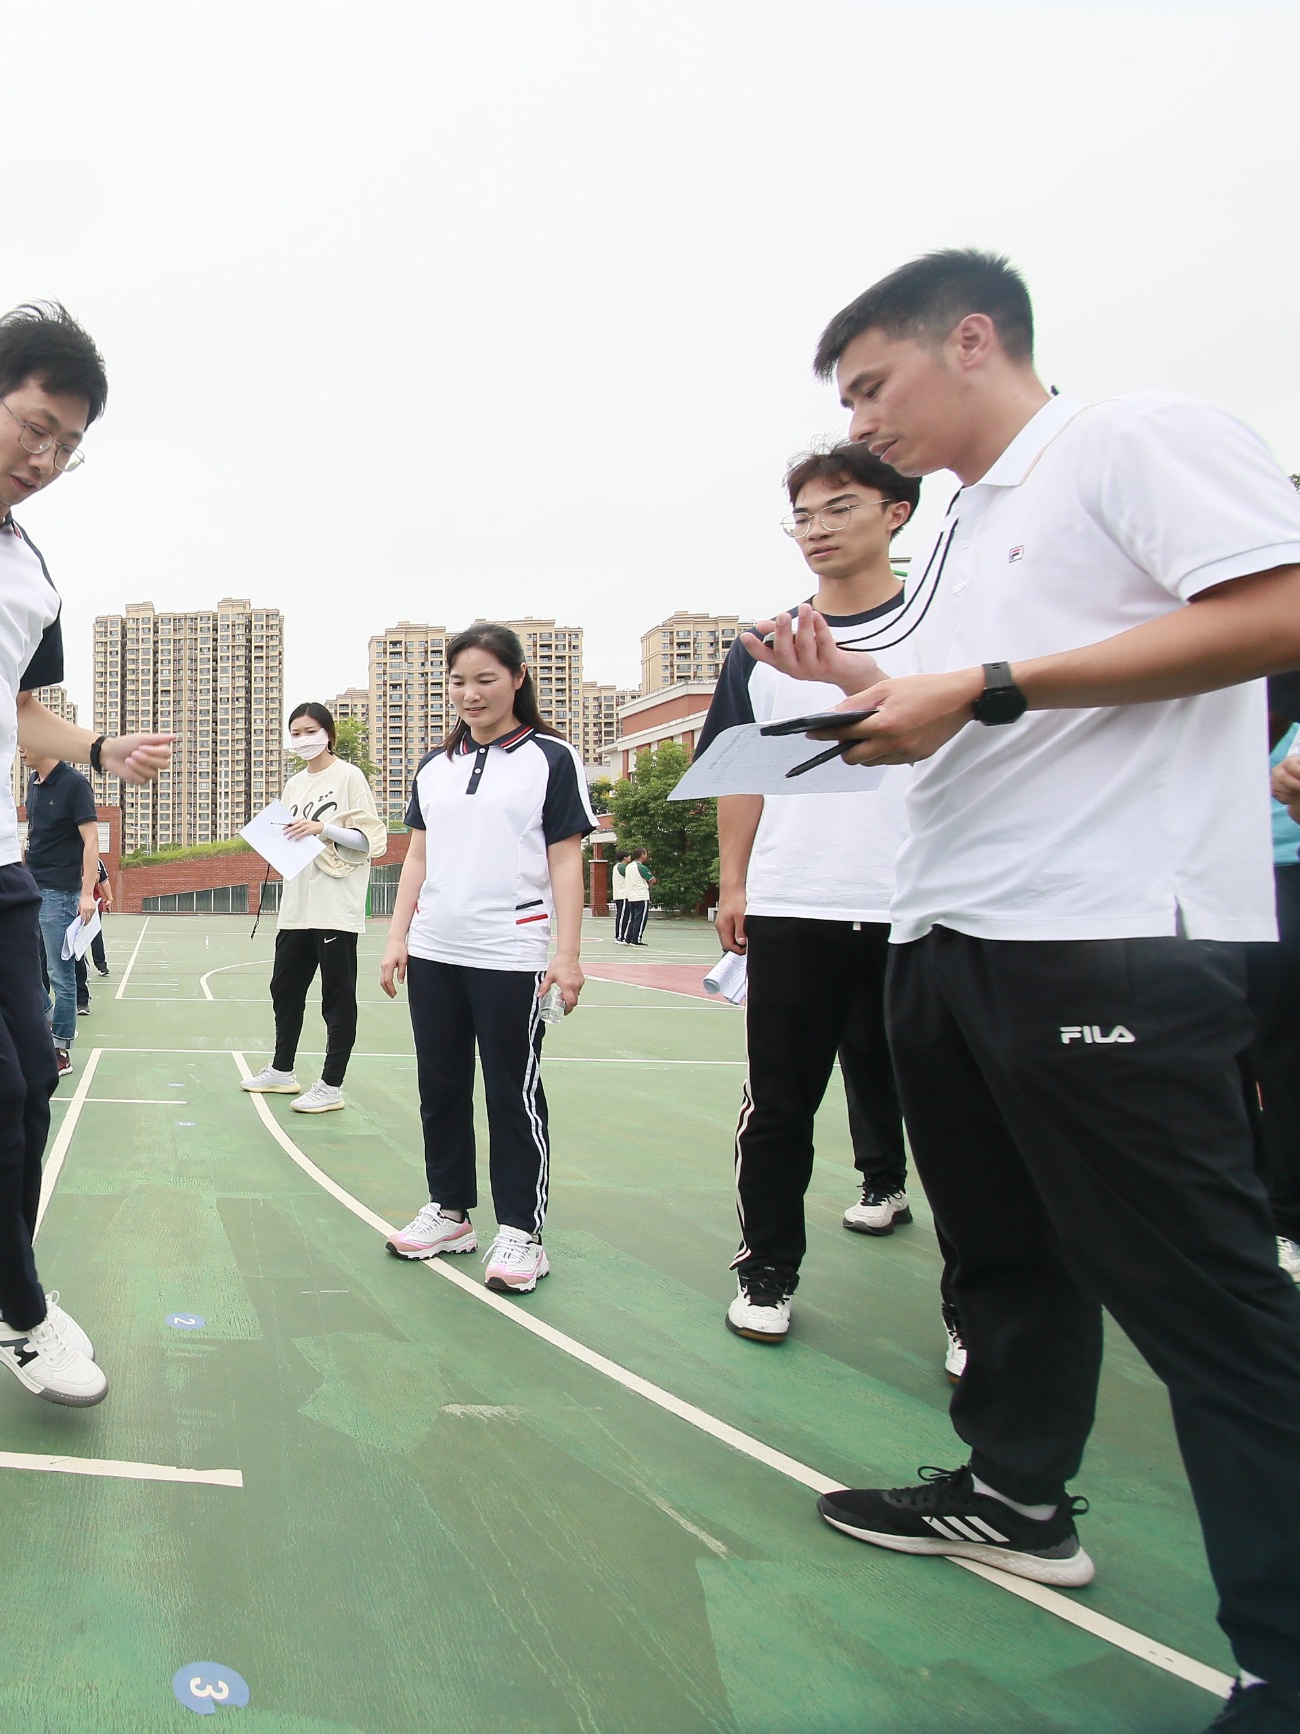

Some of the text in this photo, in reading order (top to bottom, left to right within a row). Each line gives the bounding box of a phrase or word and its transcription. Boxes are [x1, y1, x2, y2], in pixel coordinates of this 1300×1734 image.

[1060, 1025, 1136, 1044] FILA
[173, 1316, 196, 1325] 2
[189, 1676, 230, 1701] 3
